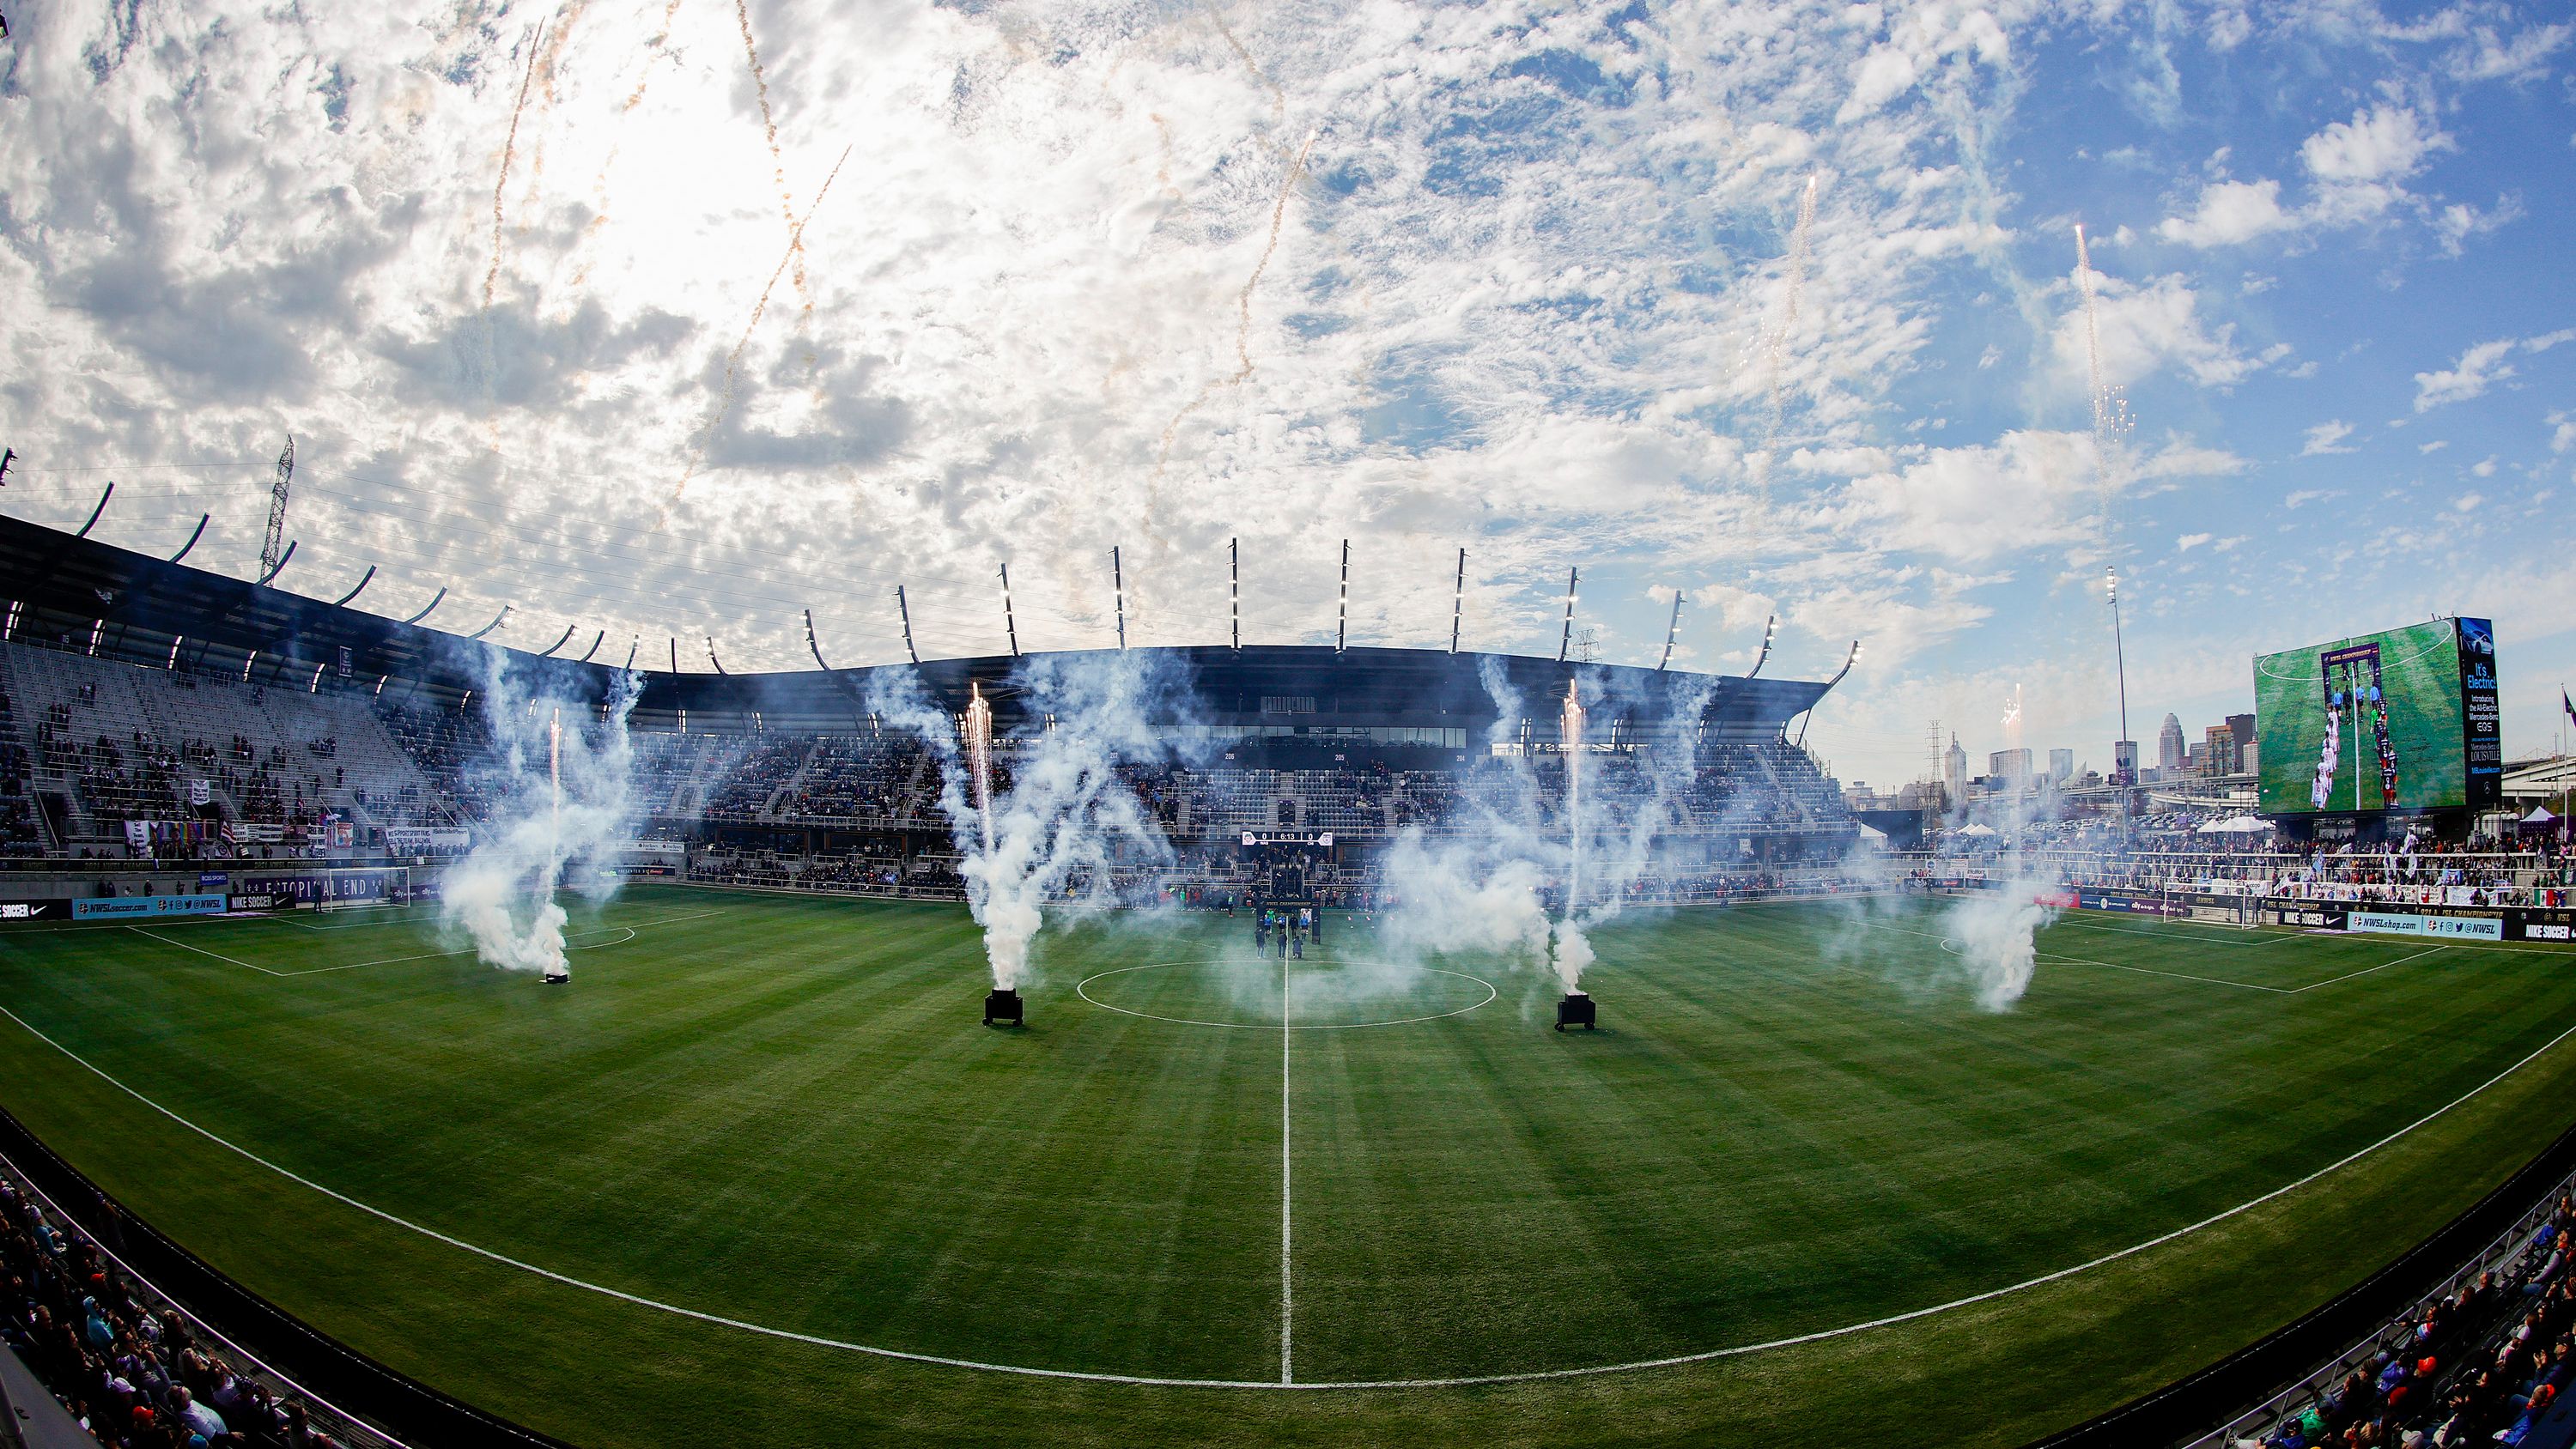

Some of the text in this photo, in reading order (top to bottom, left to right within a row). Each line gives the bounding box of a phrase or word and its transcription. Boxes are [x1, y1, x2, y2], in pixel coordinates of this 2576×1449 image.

[2475, 662, 2487, 676] It's
[2467, 675, 2497, 689] Electric!
[2471, 694, 2494, 704] Introducing
[2477, 722, 2492, 732] EQS
[2471, 751, 2500, 761] LOUISVILLE
[344, 879, 366, 895] END
[90, 904, 147, 912] NWSLsoccer.com
[194, 899, 221, 909] @NWSL
[232, 896, 272, 908] NIKE SOCCER
[2131, 902, 2141, 910] ally
[2, 904, 29, 918] SOCCER
[2284, 911, 2324, 925] NIKE SOCCER
[2363, 917, 2416, 930] NWSLshop.com
[2465, 923, 2495, 934] @NWSL
[2526, 925, 2569, 939] NIKE SOCCER
